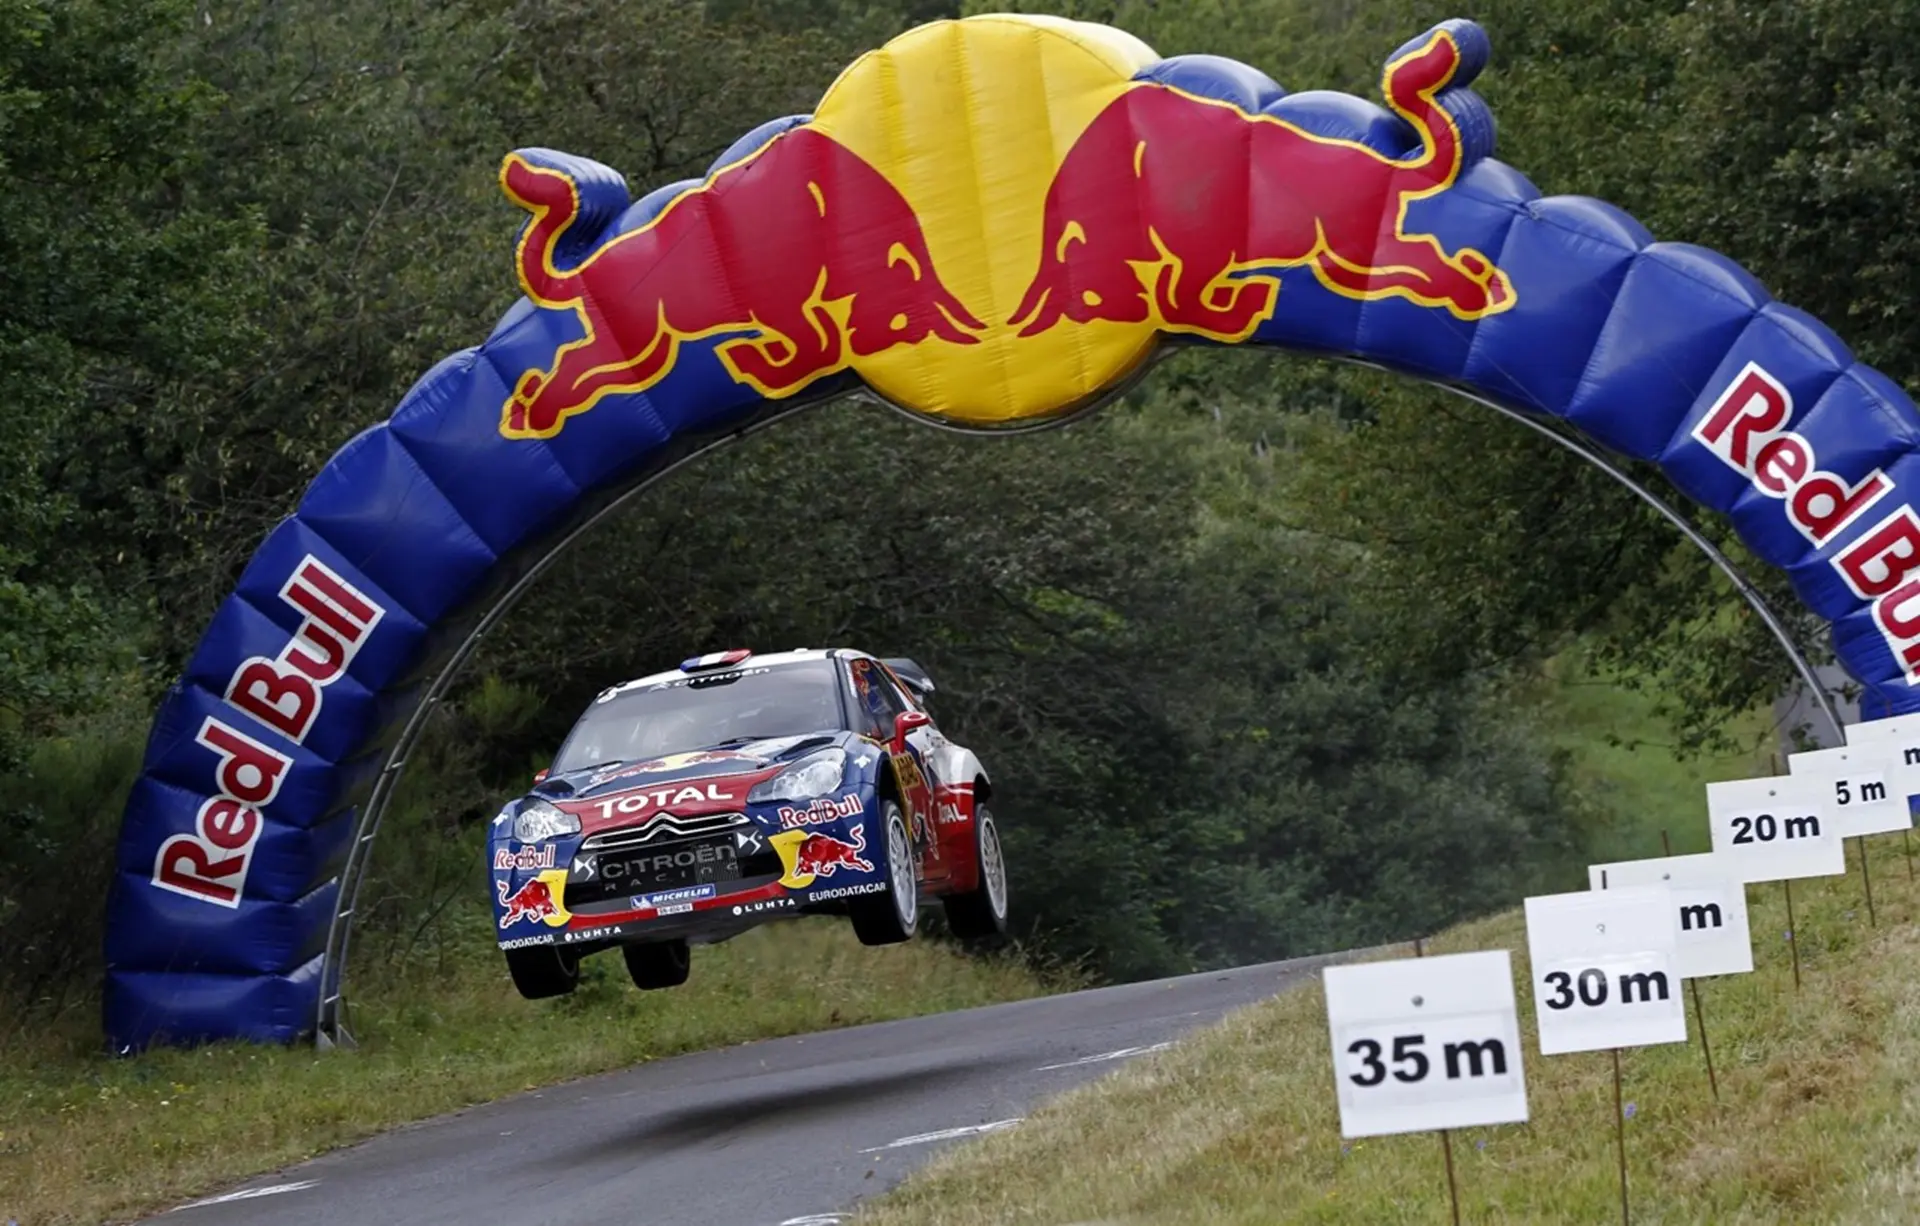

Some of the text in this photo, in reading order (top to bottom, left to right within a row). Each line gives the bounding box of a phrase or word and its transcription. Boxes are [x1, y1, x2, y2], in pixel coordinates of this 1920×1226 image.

[1695, 366, 1920, 682] Red Bu
[155, 558, 381, 905] Red Bull
[594, 784, 733, 819] TOTAL
[1861, 781, 1886, 802] m
[1731, 813, 1820, 844] 20 m
[652, 886, 711, 903] MICHELIN
[809, 882, 886, 902] EURODATACAR
[1680, 901, 1722, 930] m
[1543, 968, 1669, 1010] 30 m
[1347, 1035, 1507, 1087] 35 m
